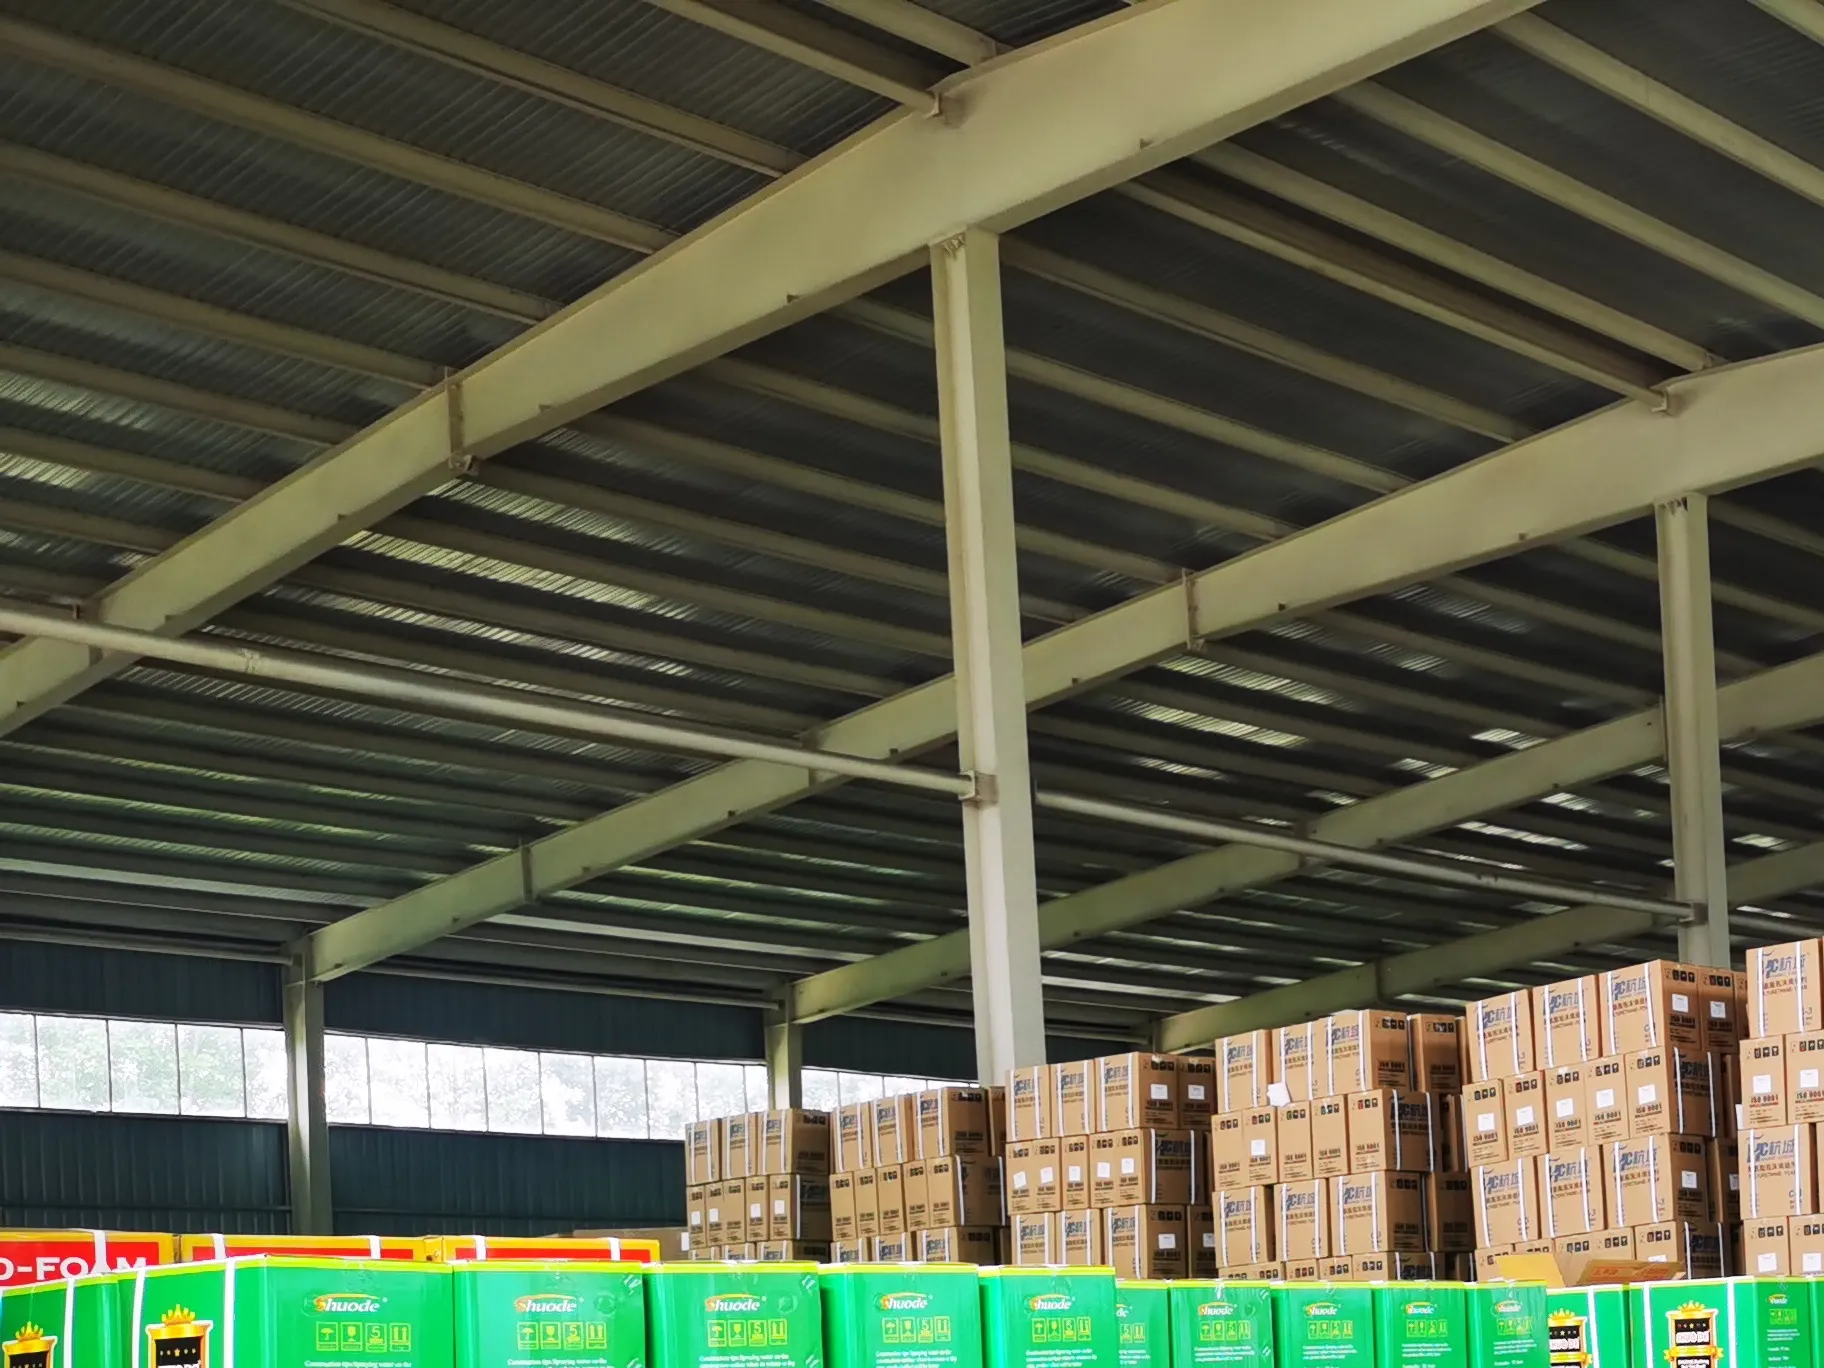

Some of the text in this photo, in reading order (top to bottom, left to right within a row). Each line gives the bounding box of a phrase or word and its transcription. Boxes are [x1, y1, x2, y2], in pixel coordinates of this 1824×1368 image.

[313, 1294, 380, 1313] Shuode
[514, 1295, 577, 1313] Shuode
[704, 1294, 761, 1313] Shuode
[878, 1294, 928, 1311] Shuode
